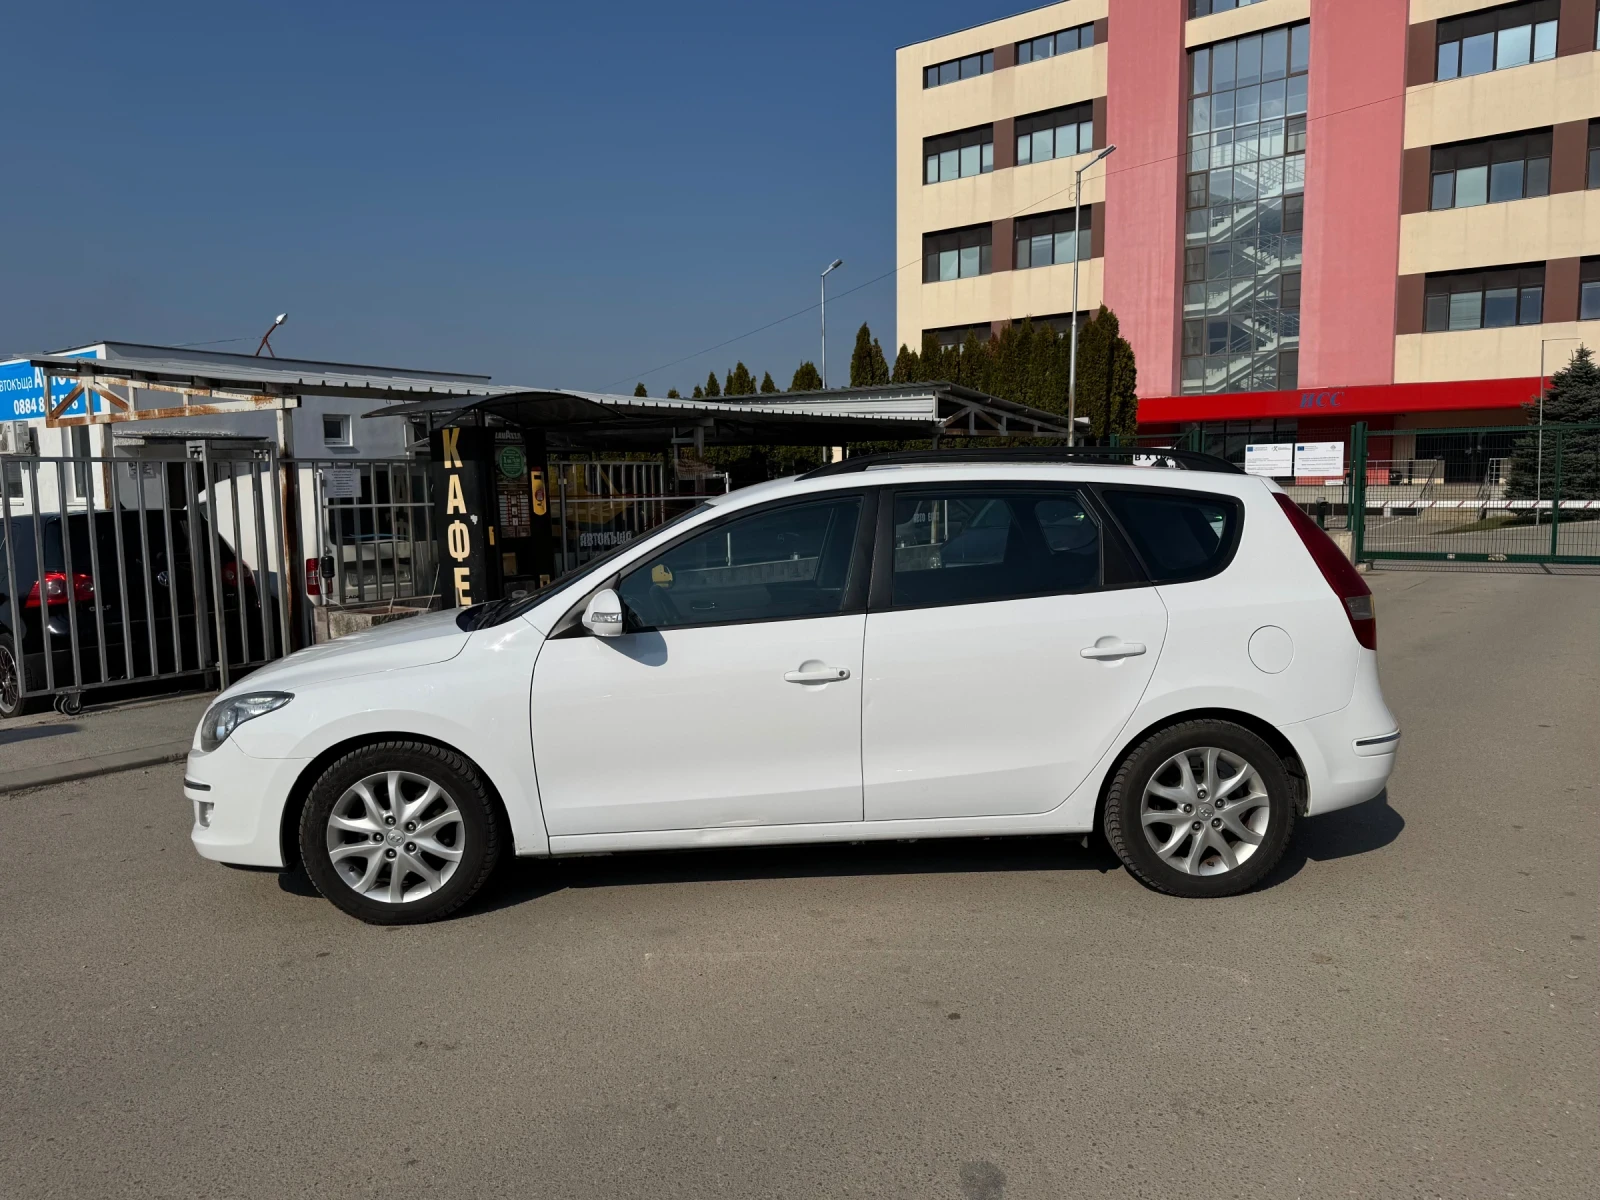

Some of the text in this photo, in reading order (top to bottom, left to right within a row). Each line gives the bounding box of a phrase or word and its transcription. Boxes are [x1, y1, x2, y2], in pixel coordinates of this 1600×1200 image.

[13, 398, 37, 415] 0884
[38, 396, 58, 413] 85
[442, 427, 473, 606] КАФЕ
